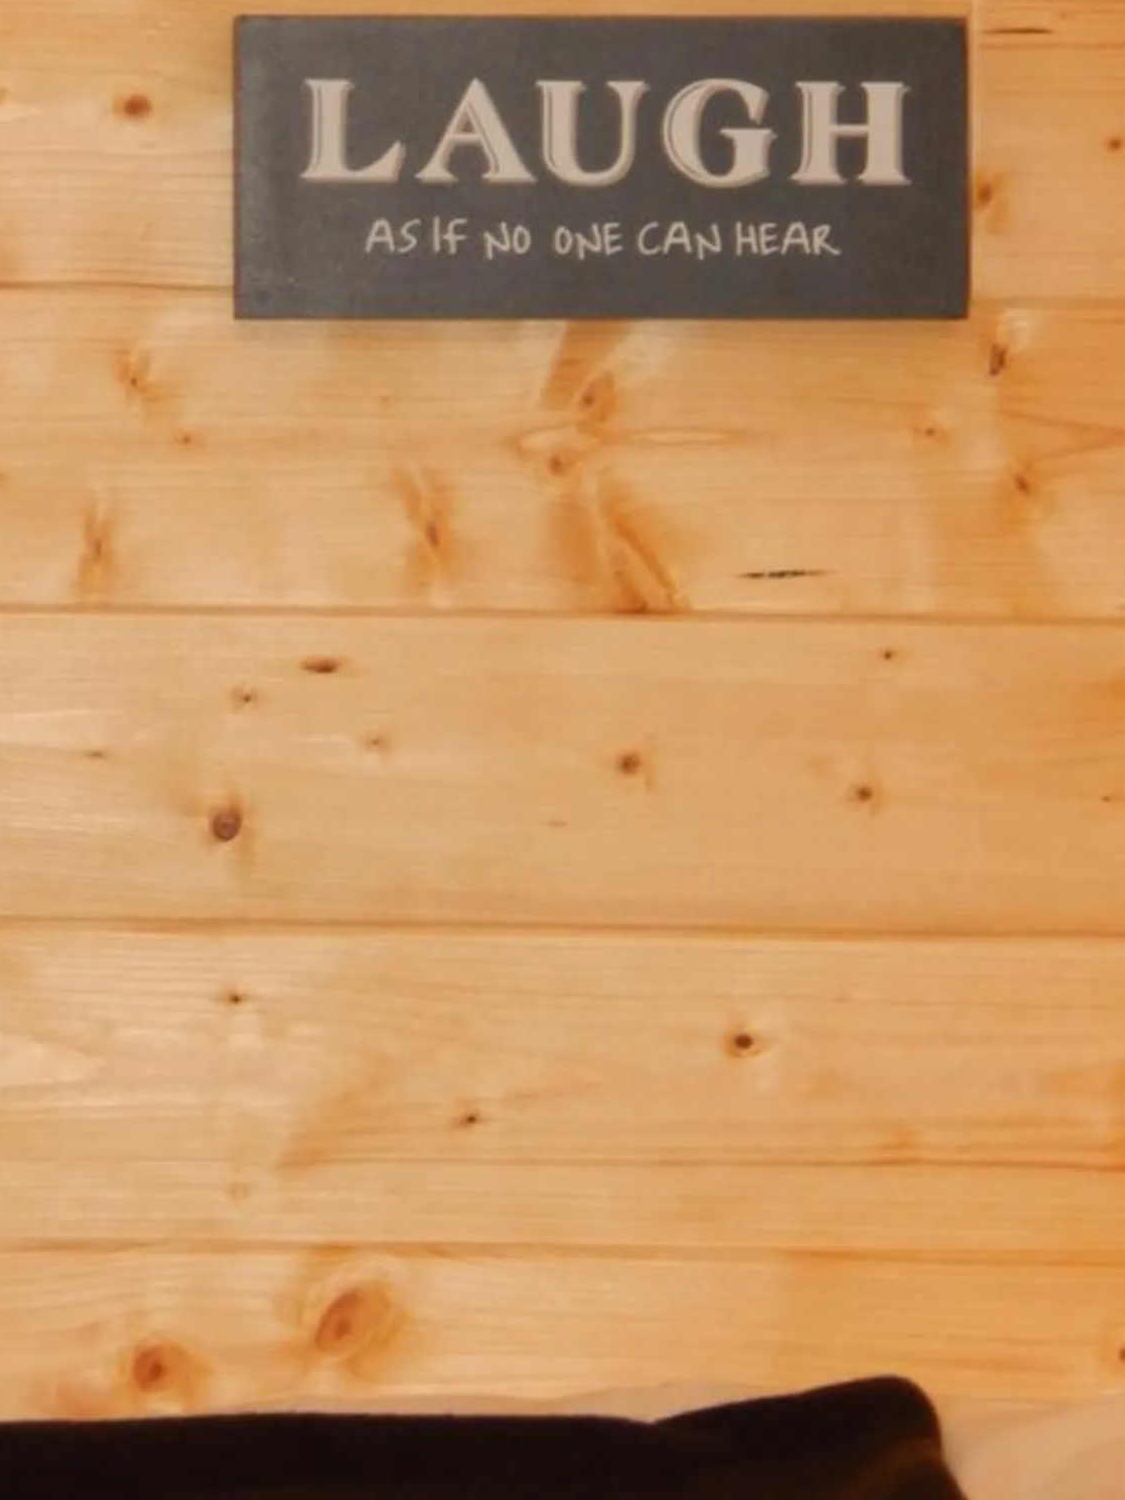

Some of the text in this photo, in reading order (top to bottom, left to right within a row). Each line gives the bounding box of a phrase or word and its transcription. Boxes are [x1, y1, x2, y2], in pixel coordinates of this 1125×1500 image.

[298, 76, 912, 189] LAUGH
[363, 215, 842, 262] AS IF NO ONE CAN HEAR
